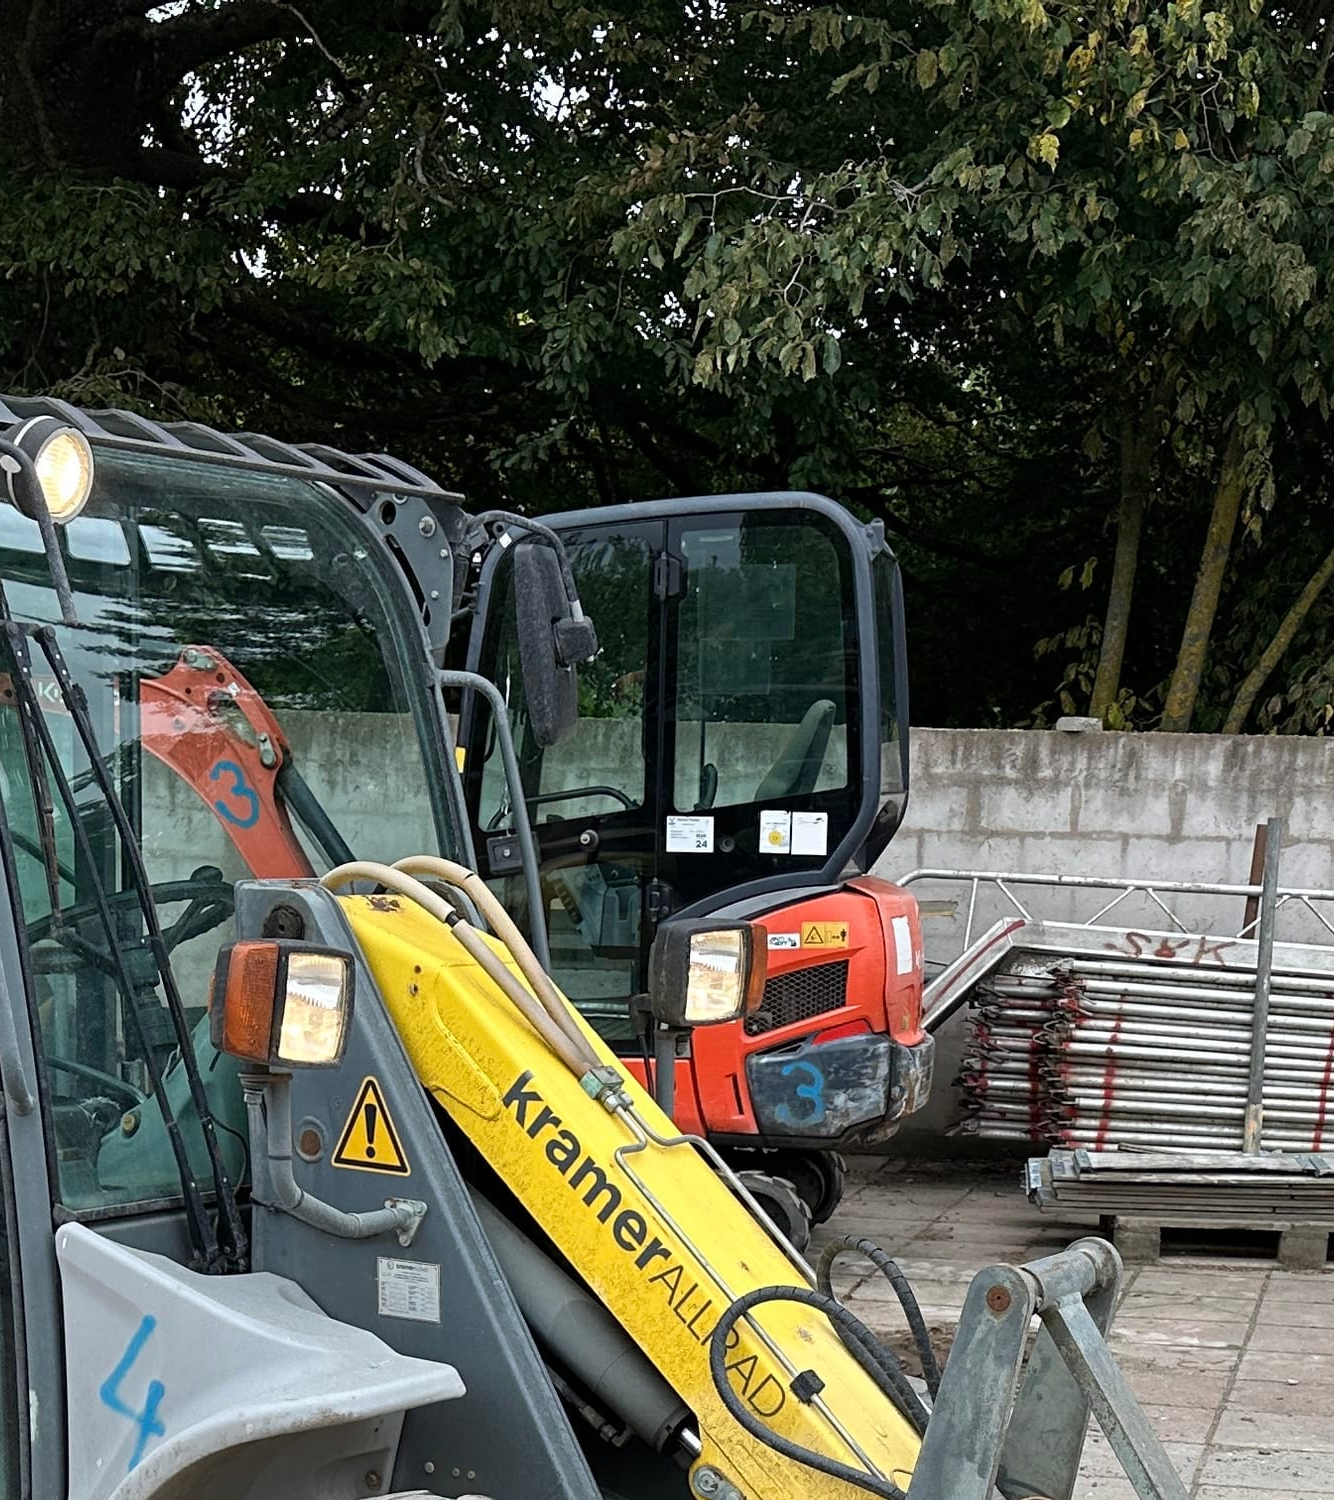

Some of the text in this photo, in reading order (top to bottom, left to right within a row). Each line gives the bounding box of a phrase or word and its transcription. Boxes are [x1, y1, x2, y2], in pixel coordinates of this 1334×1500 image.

[210, 760, 260, 829] 3
[775, 1061, 824, 1128] 3
[100, 1314, 166, 1473] 4
